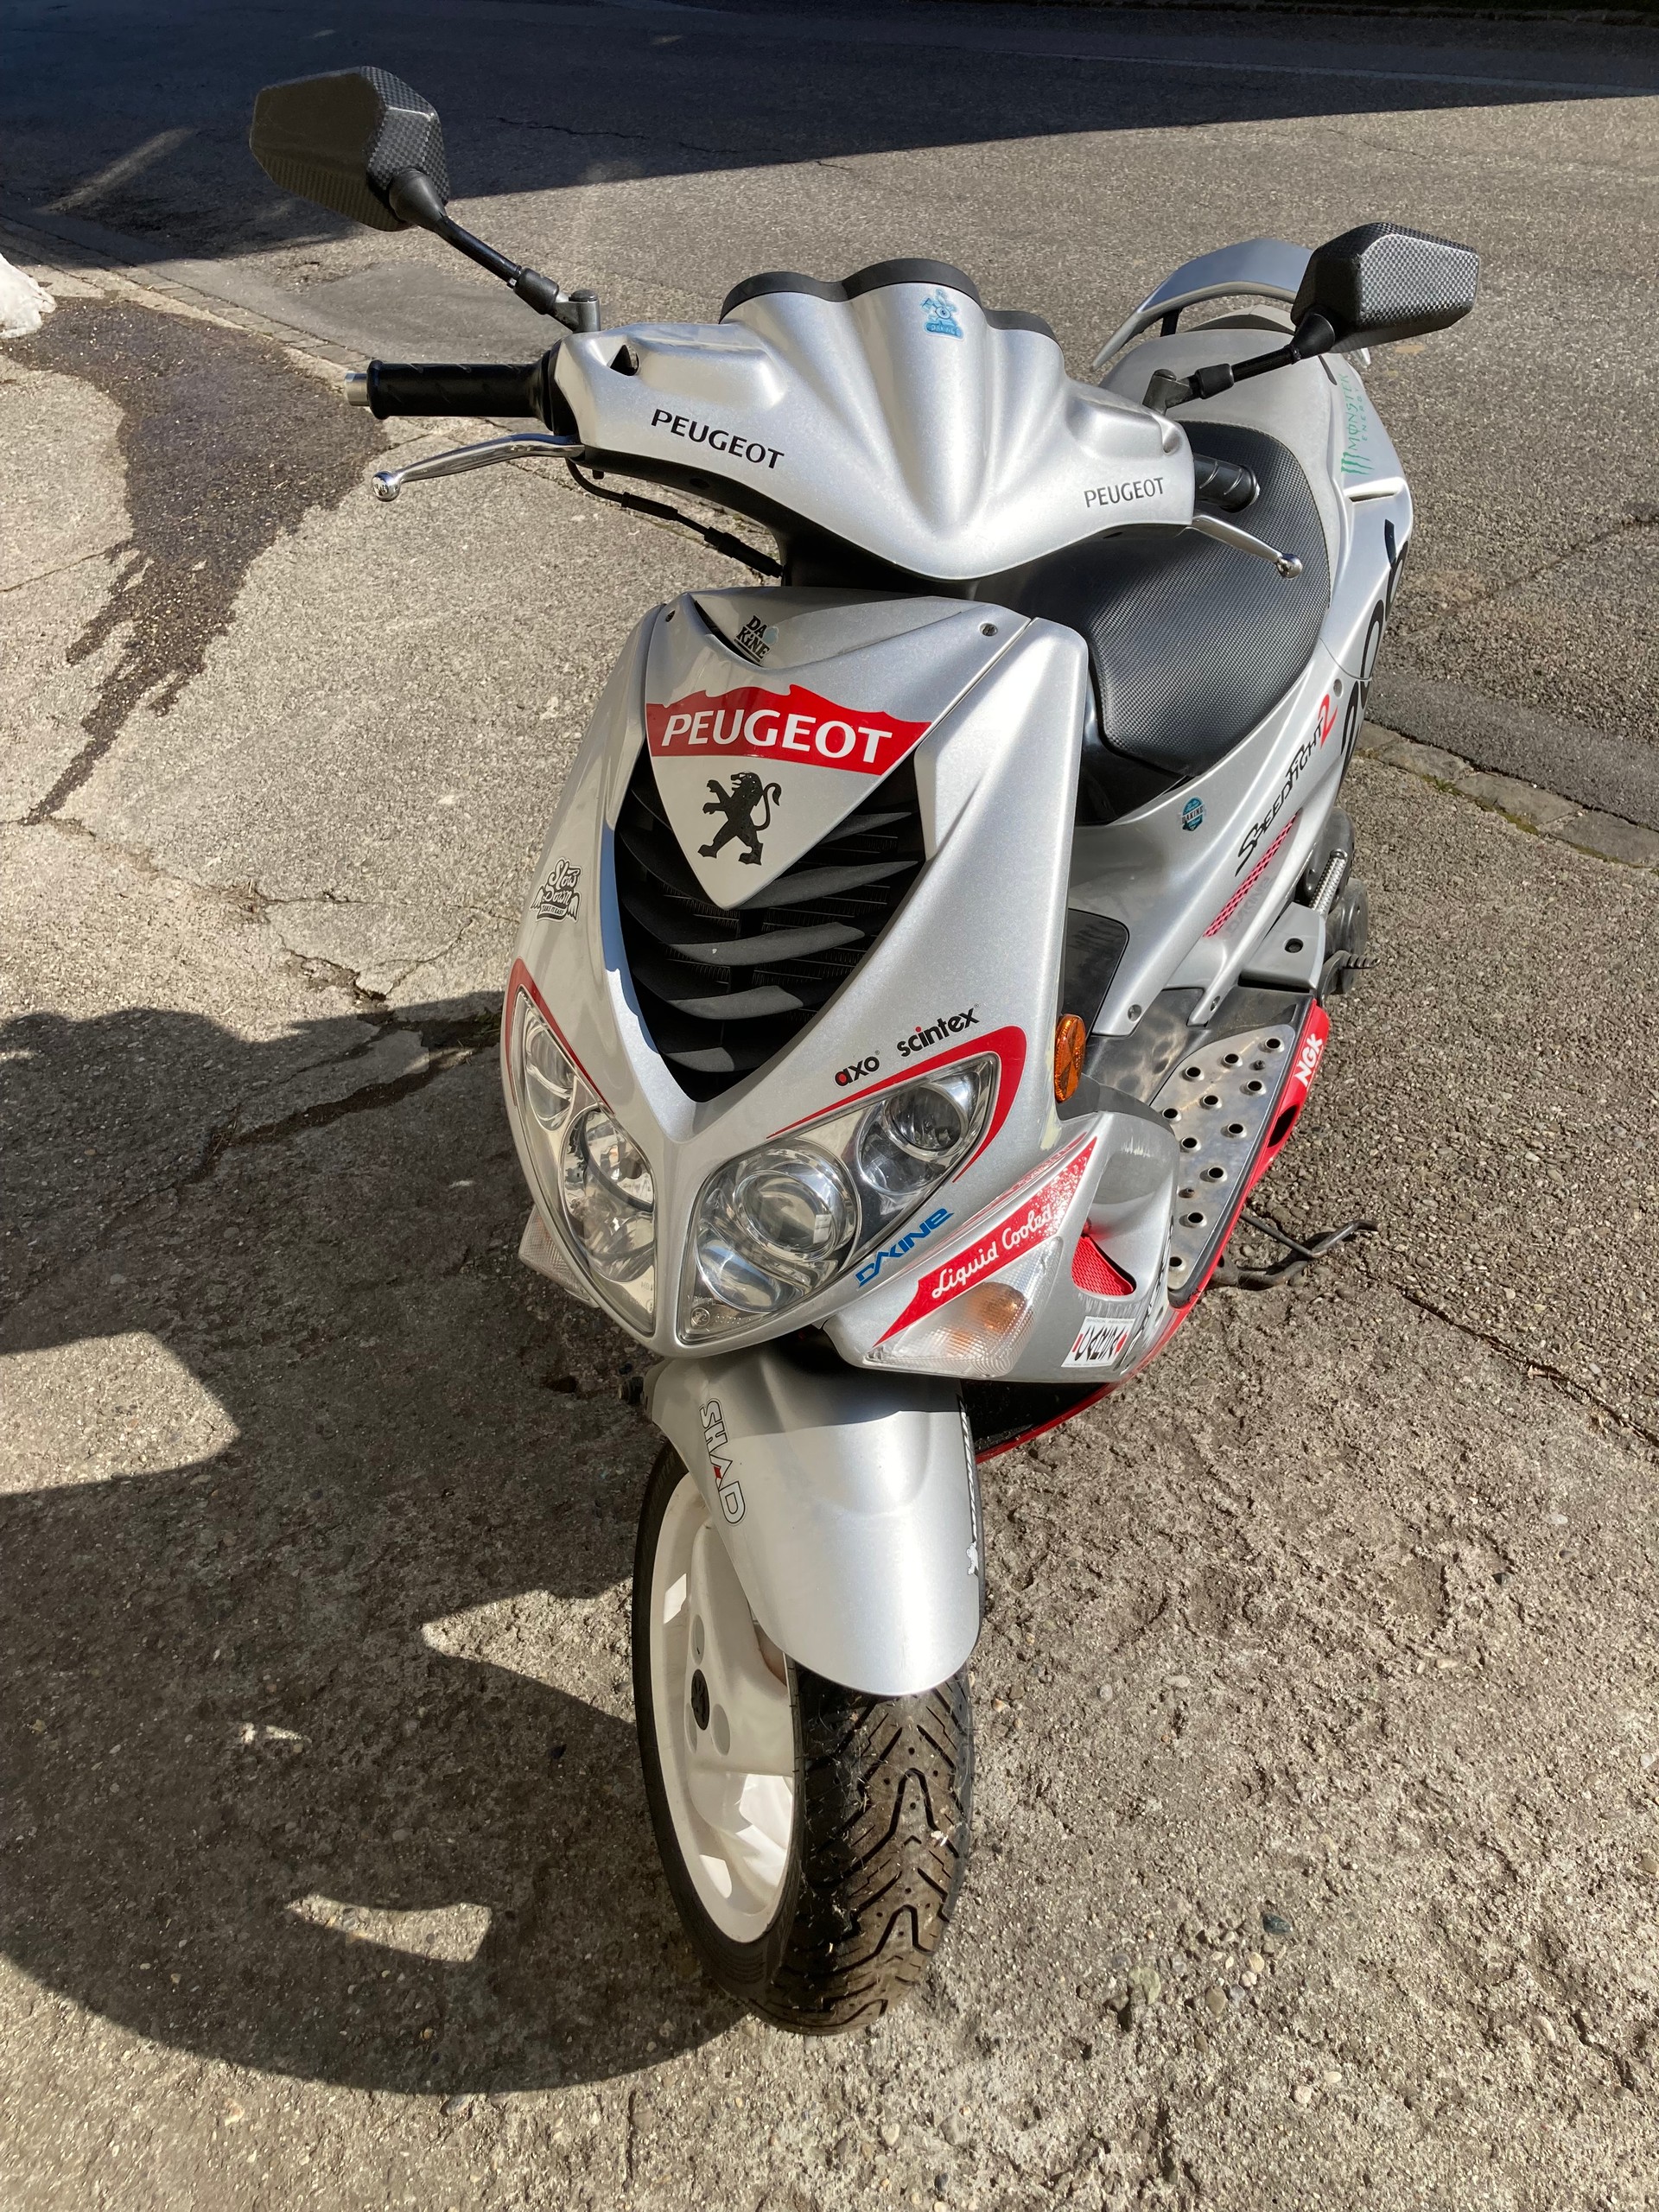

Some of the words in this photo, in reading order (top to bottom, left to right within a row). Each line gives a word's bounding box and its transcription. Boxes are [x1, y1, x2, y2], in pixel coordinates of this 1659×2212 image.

[651, 408, 785, 469] PEUGEOT
[1084, 477, 1164, 508] PEUGEOT
[746, 614, 768, 639] DA
[661, 709, 893, 764] PEUGEOT
[543, 884, 573, 906] Down
[548, 858, 581, 891] Slow
[835, 1056, 880, 1086] axo
[897, 1007, 980, 1057] scintex
[1294, 1033, 1323, 1088] NGK
[931, 1241, 999, 1299] Liquid
[1001, 1203, 1052, 1250] Cooled
[699, 1400, 746, 1524] SHAD
